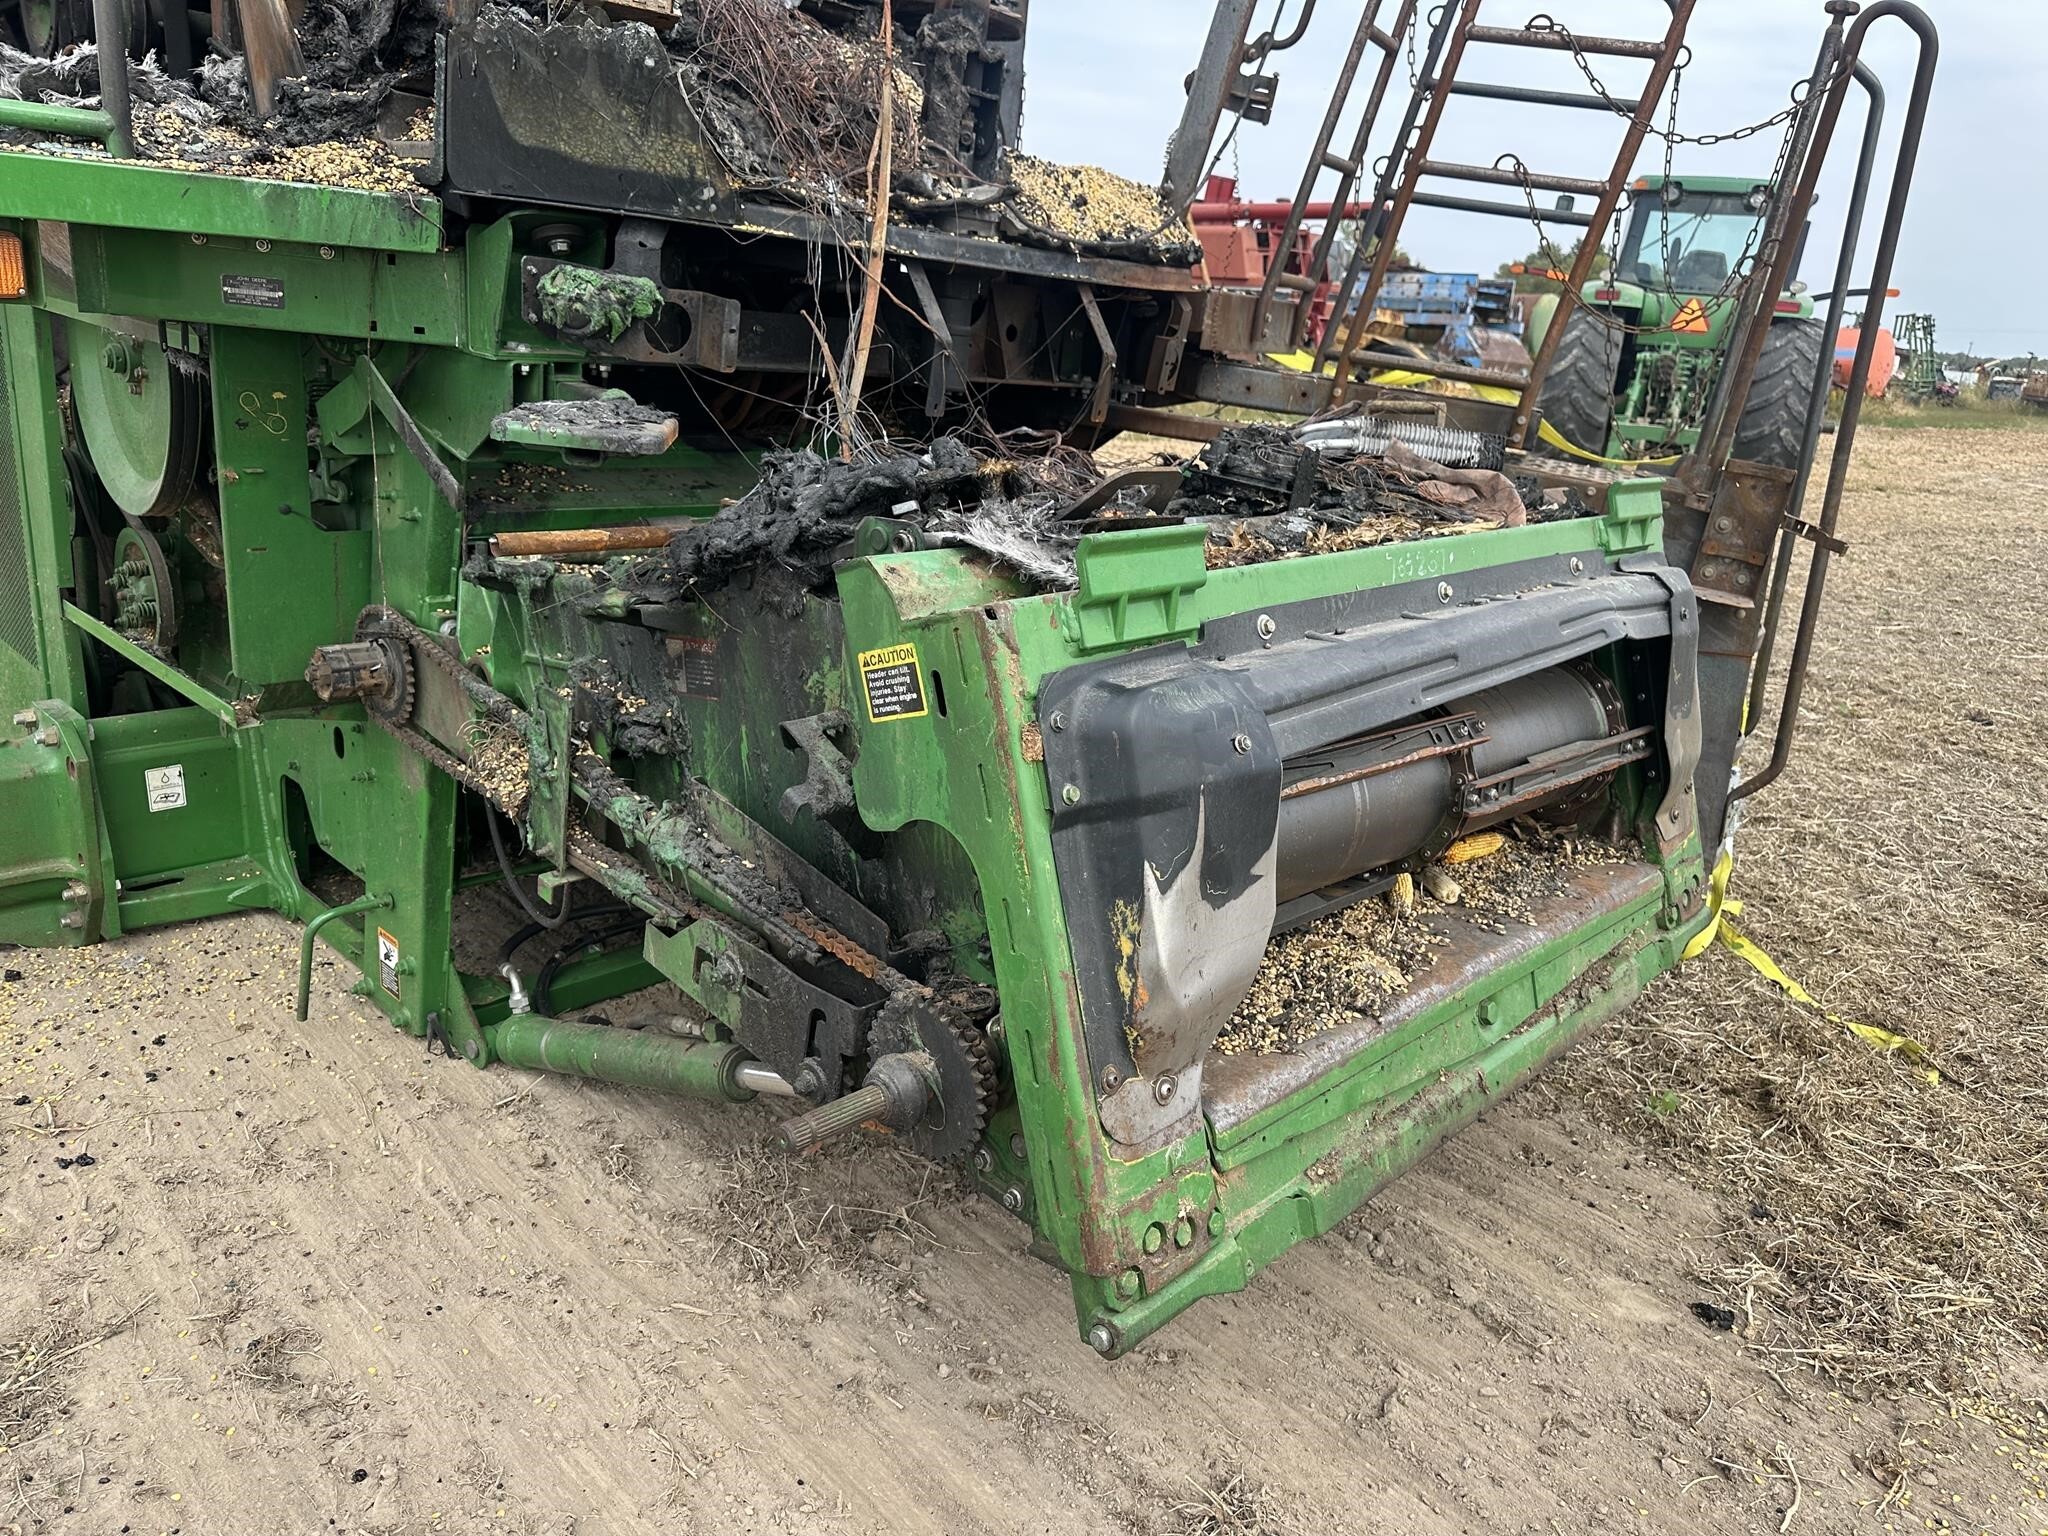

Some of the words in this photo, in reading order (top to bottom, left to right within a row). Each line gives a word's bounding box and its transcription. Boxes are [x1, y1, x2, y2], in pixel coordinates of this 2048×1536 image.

[869, 647, 914, 667] CAUTION
[866, 670, 887, 680] Header
[888, 668, 899, 676] can
[869, 680, 885, 688] Avoid
[885, 675, 910, 685] crushing
[870, 687, 893, 697] injuries.
[893, 685, 907, 694] Stay
[872, 697, 885, 705] clear
[884, 695, 899, 703] when
[899, 692, 917, 702] engine
[873, 706, 879, 714] is
[879, 704, 902, 713] running.
